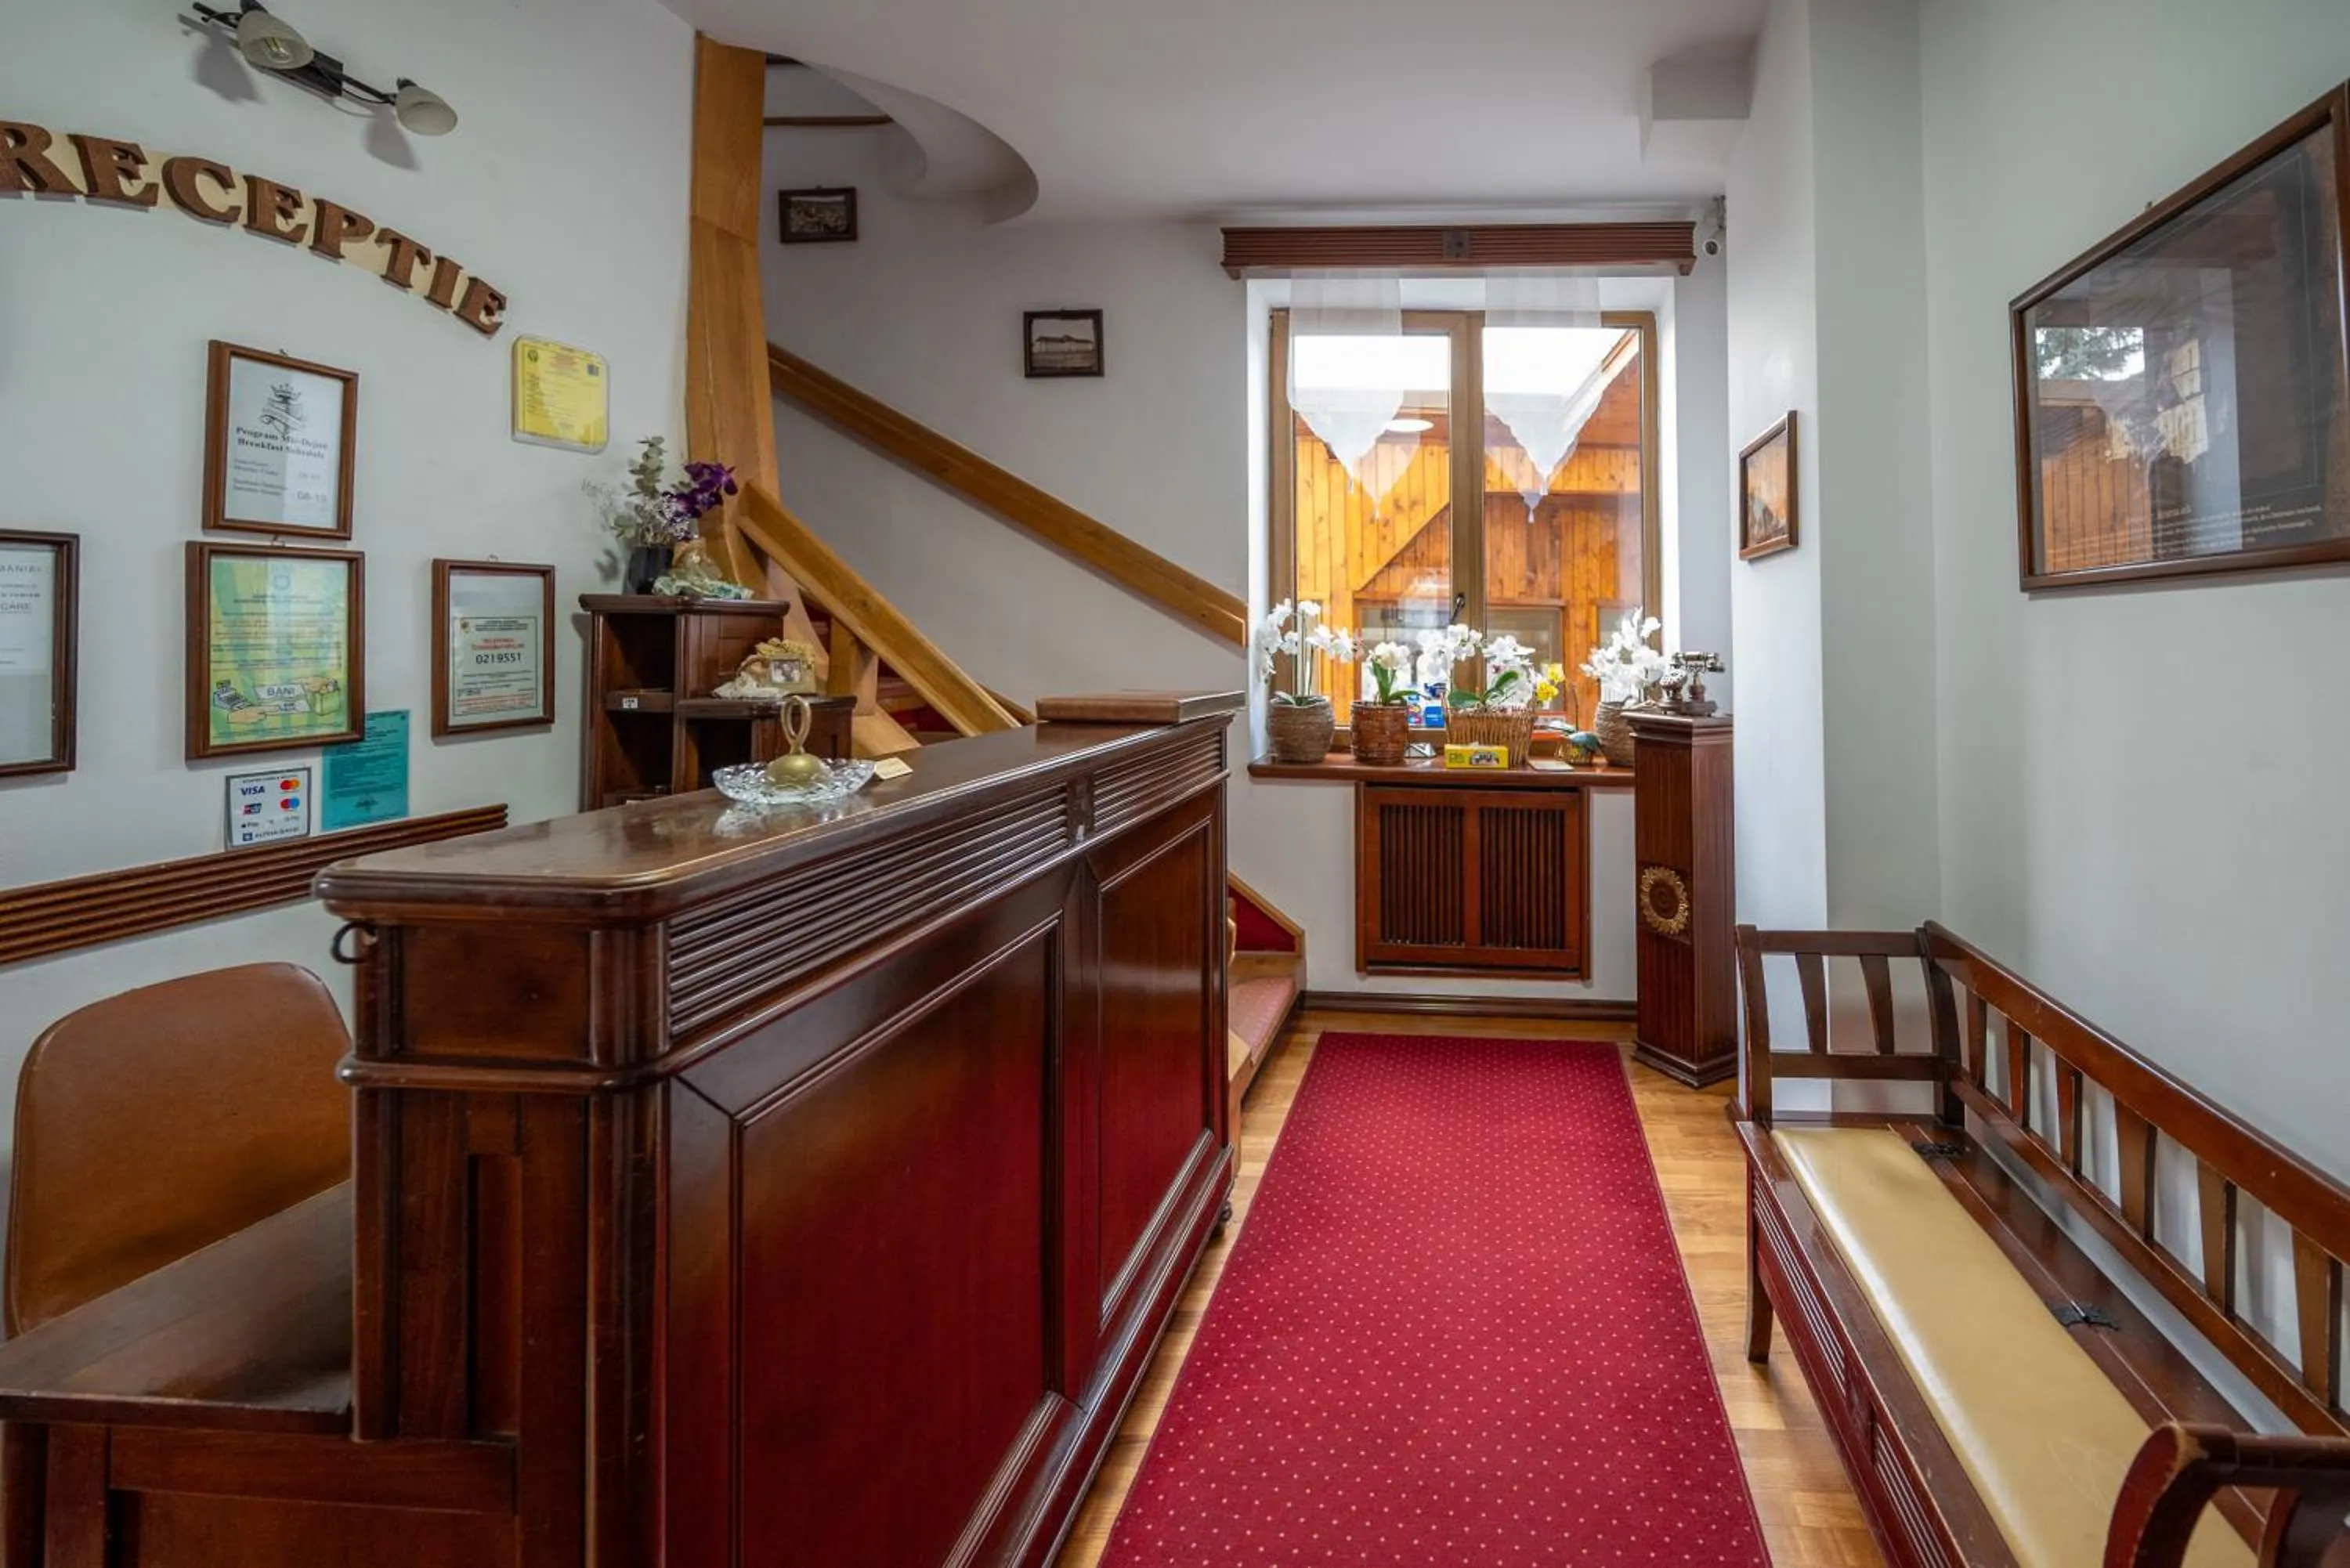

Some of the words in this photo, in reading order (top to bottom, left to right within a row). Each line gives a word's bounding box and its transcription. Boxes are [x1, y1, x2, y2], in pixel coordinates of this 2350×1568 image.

[0, 120, 508, 338] RECEPTIE
[475, 652, 522, 664] 0219551
[267, 687, 295, 696] BANI
[240, 786, 266, 796] VISA
